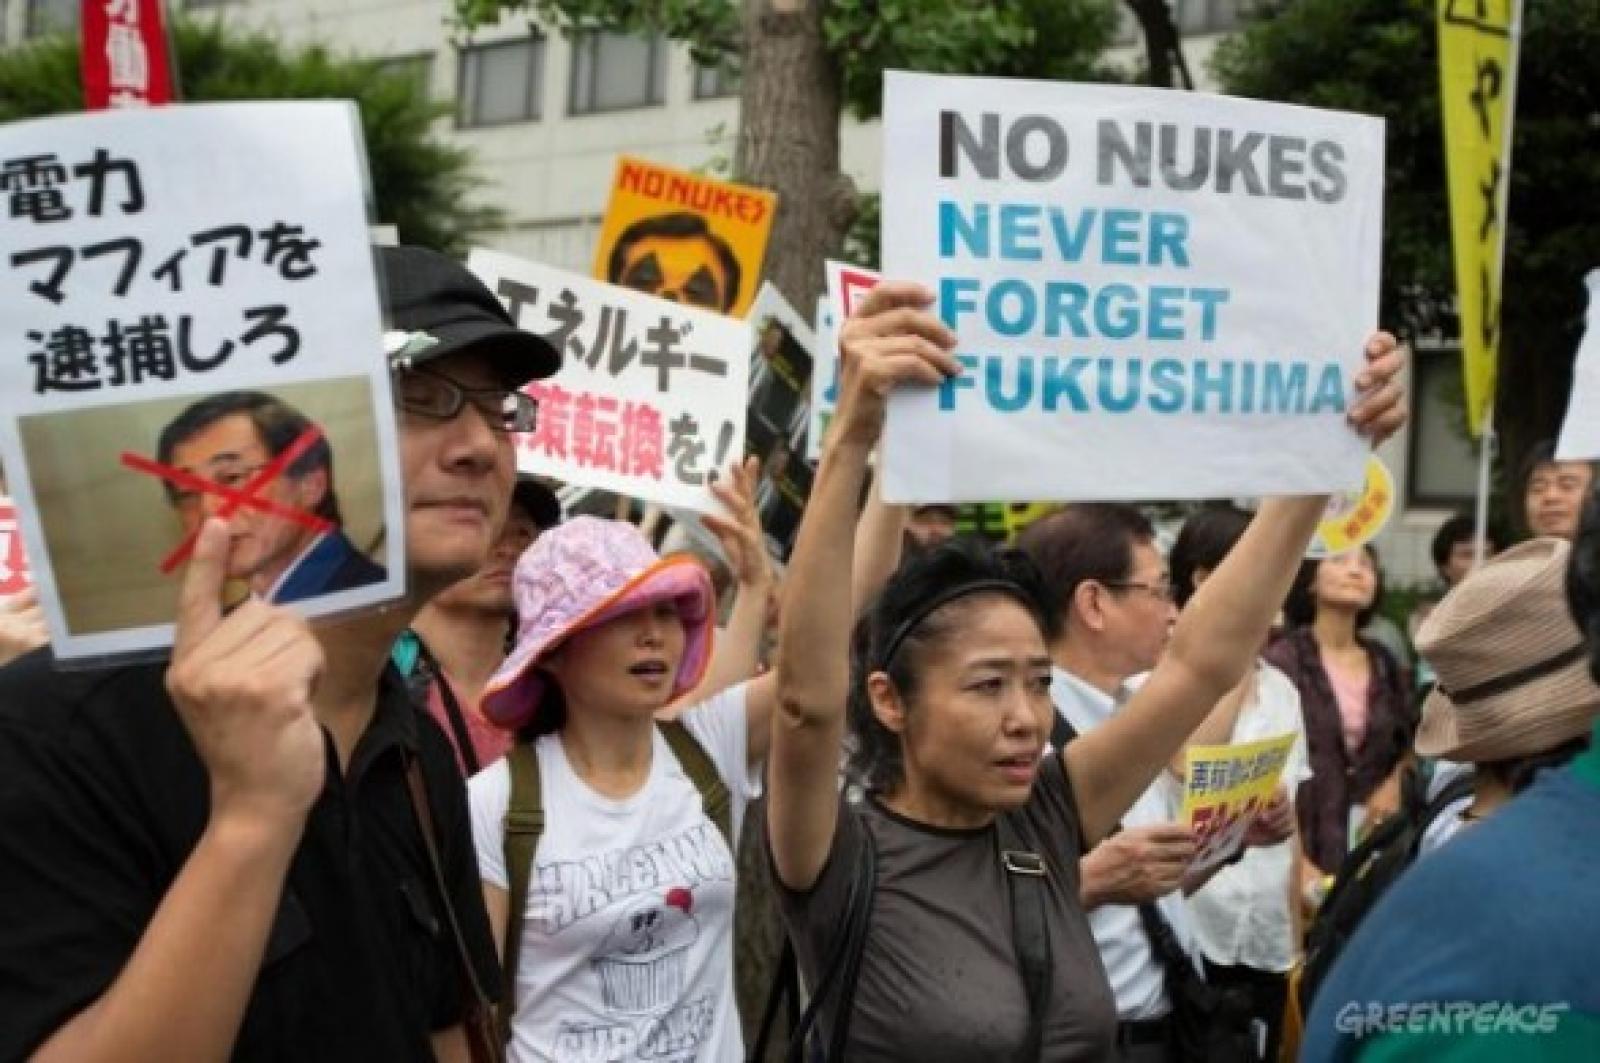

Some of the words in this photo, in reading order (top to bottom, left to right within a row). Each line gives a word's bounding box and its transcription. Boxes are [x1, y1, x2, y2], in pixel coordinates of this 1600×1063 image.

[0, 149, 144, 223] 電力
[940, 110, 1069, 182] NO
[1096, 119, 1347, 203] NUKES
[10, 222, 322, 303] マフィアを
[938, 200, 1191, 267] NEVER
[938, 277, 1232, 341] FORGET
[26, 304, 302, 394] 逮捕しろ
[938, 355, 1346, 414] FUKUSHIMA
